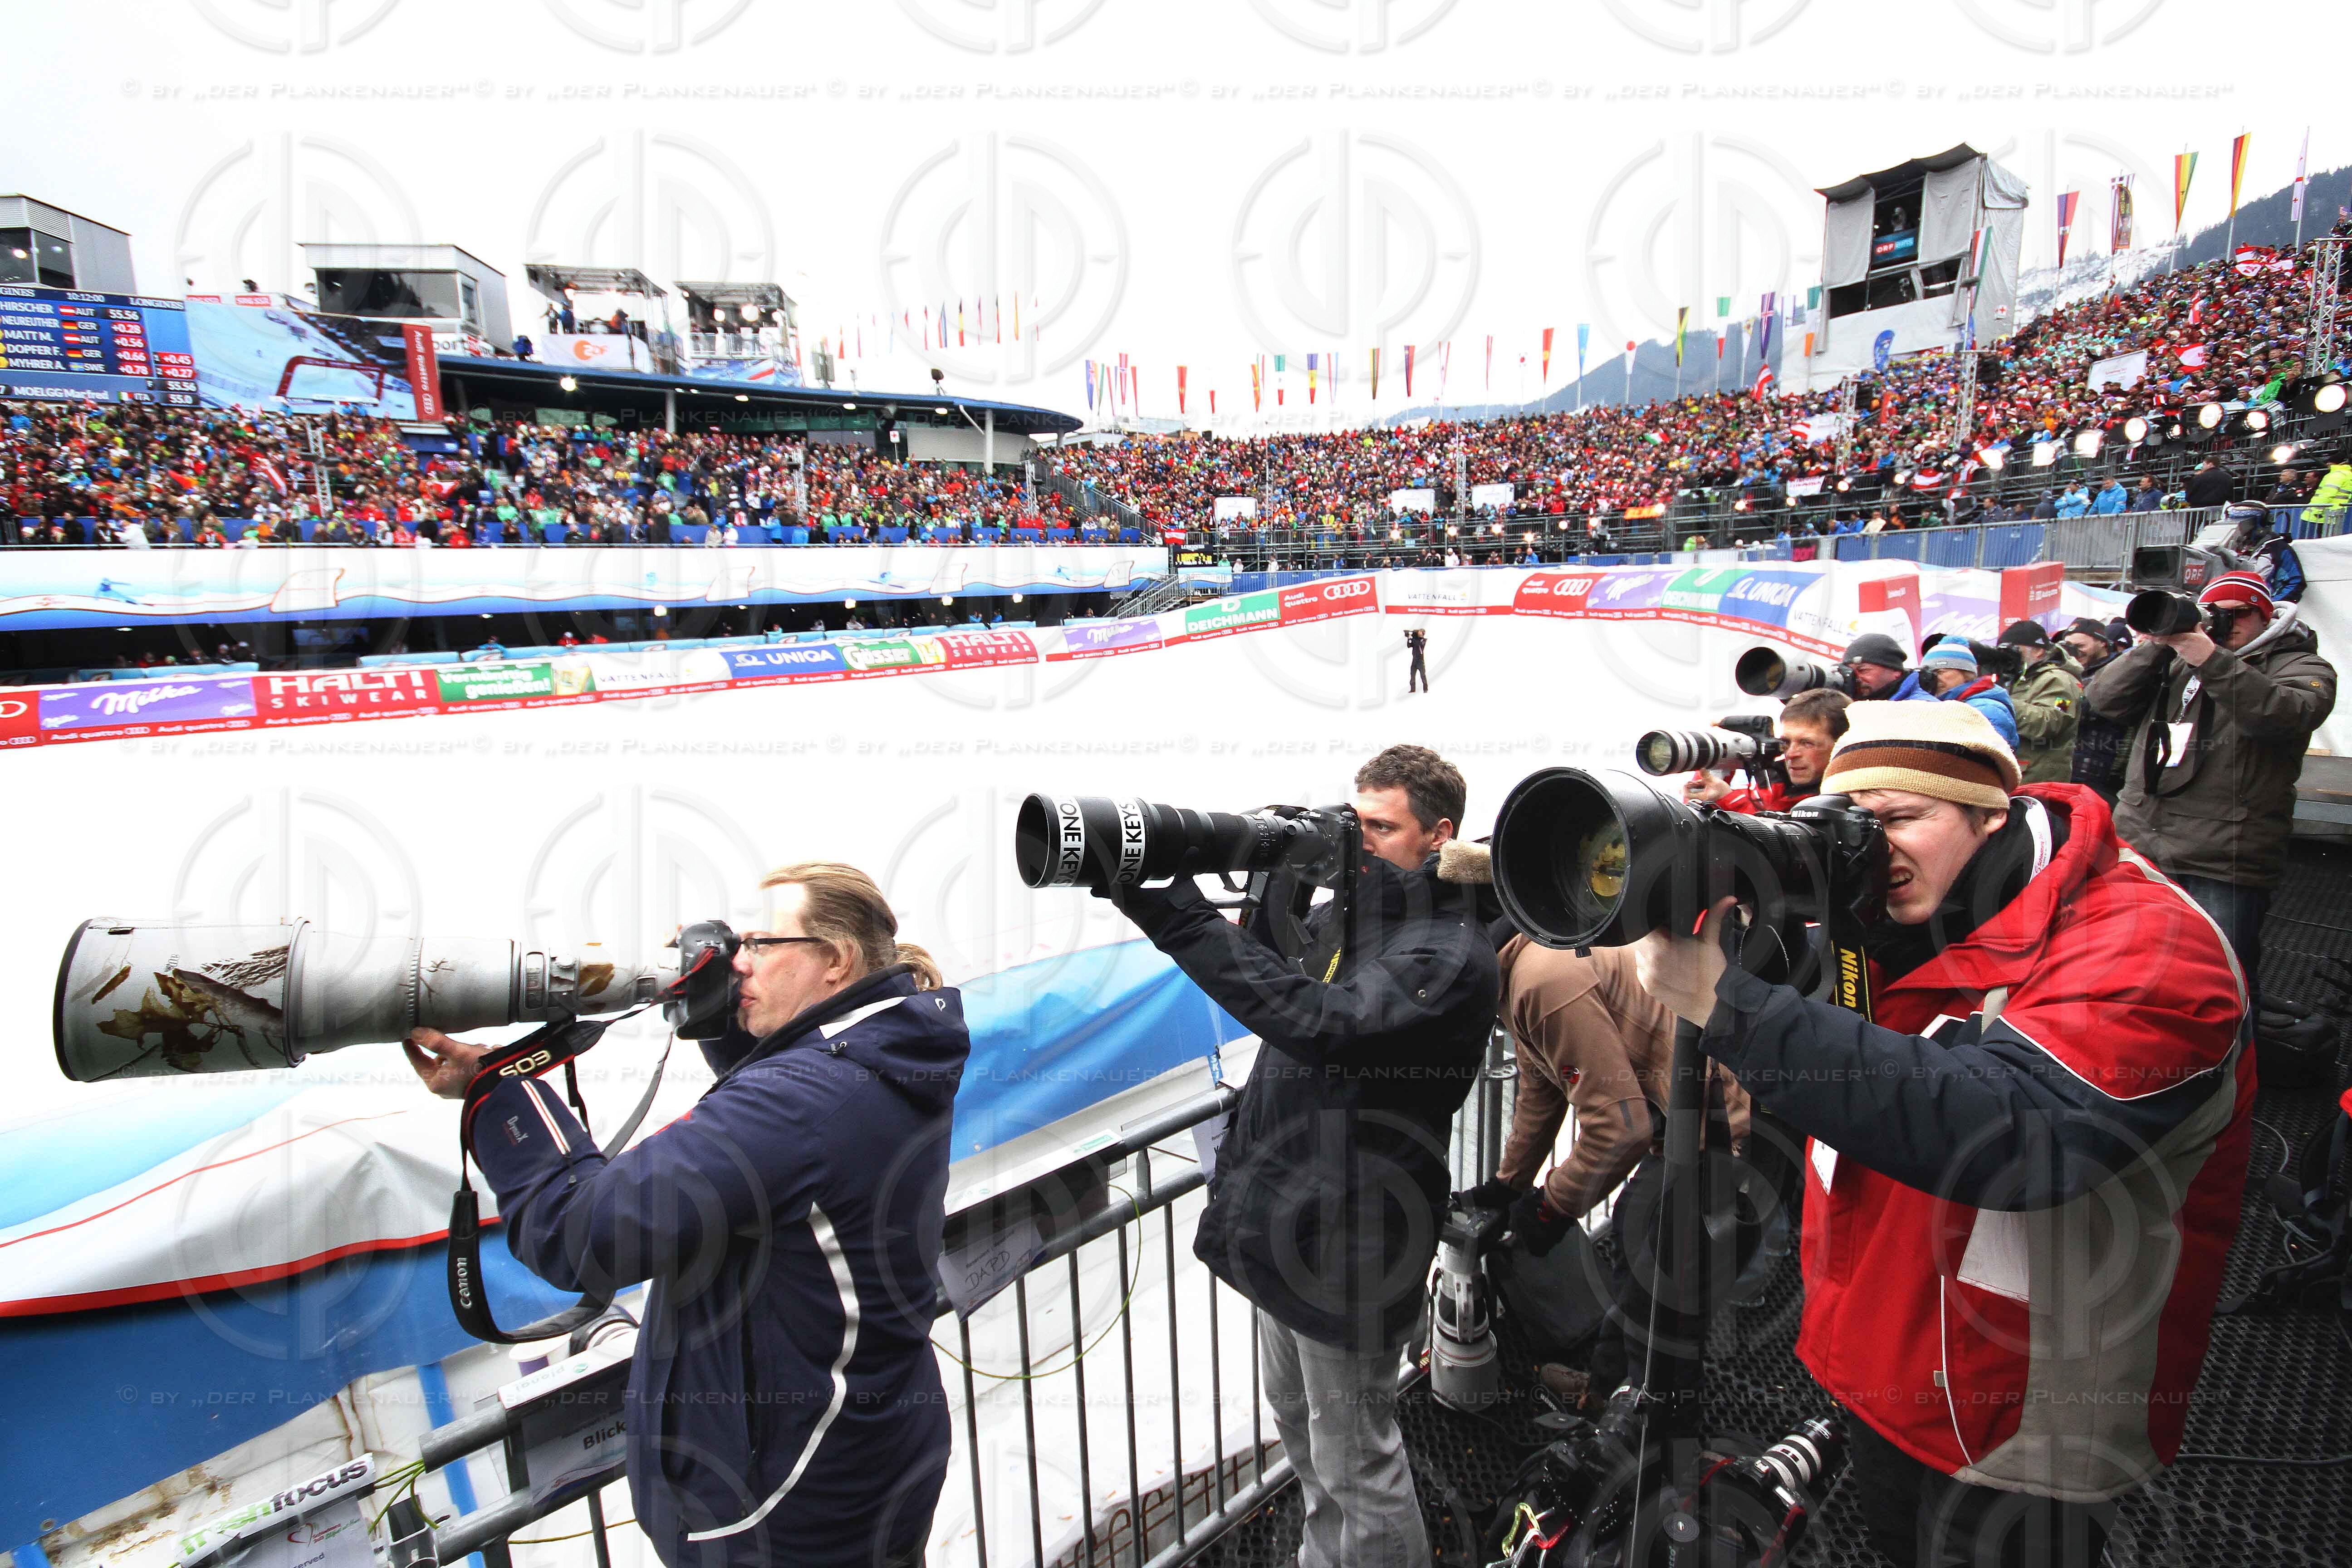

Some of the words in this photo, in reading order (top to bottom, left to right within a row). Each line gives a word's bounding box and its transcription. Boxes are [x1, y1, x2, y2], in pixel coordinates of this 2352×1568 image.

[67, 293, 105, 303] 10:12:00
[130, 298, 185, 310] LONGINES
[0, 302, 54, 314] HIRSCHER
[76, 308, 95, 317] AUT
[109, 309, 138, 320] 55.56
[3, 318, 60, 328] NEUREUTHER
[77, 322, 98, 331] GER
[112, 324, 141, 333] +0.28
[5, 330, 36, 340] MATT
[80, 336, 100, 344] AUT
[114, 338, 144, 348] +0.56
[414, 330, 425, 353] Audi
[7, 344, 50, 355] DOPFER
[82, 349, 102, 358] GER
[117, 351, 146, 362] +0.66
[162, 354, 192, 365] +0.45
[9, 358, 53, 369] MYHRER
[84, 363, 106, 372] SWE
[119, 365, 149, 375] +0.78
[164, 368, 193, 378] +0.27
[416, 355, 429, 391] quattro
[167, 380, 197, 391] 55.56
[14, 386, 64, 397] MOELGG
[64, 388, 109, 400] Manfred
[134, 393, 151, 402] ITA
[170, 394, 193, 404] 55.0
[2185, 568, 2203, 580] ORF
[1284, 592, 1304, 601] Audi
[1284, 597, 1318, 608] quattro
[1188, 608, 1278, 632] DEICHMANN
[944, 632, 1027, 648] HALTI
[766, 650, 836, 665] UNIQA
[269, 671, 425, 695] HALTI
[89, 684, 204, 715] Milka
[1791, 810, 1818, 818] Nikon
[1840, 948, 1857, 1008] Nikon
[499, 1050, 551, 1076] EOS
[457, 1257, 472, 1309] Canon
[583, 1421, 626, 1450] Blick
